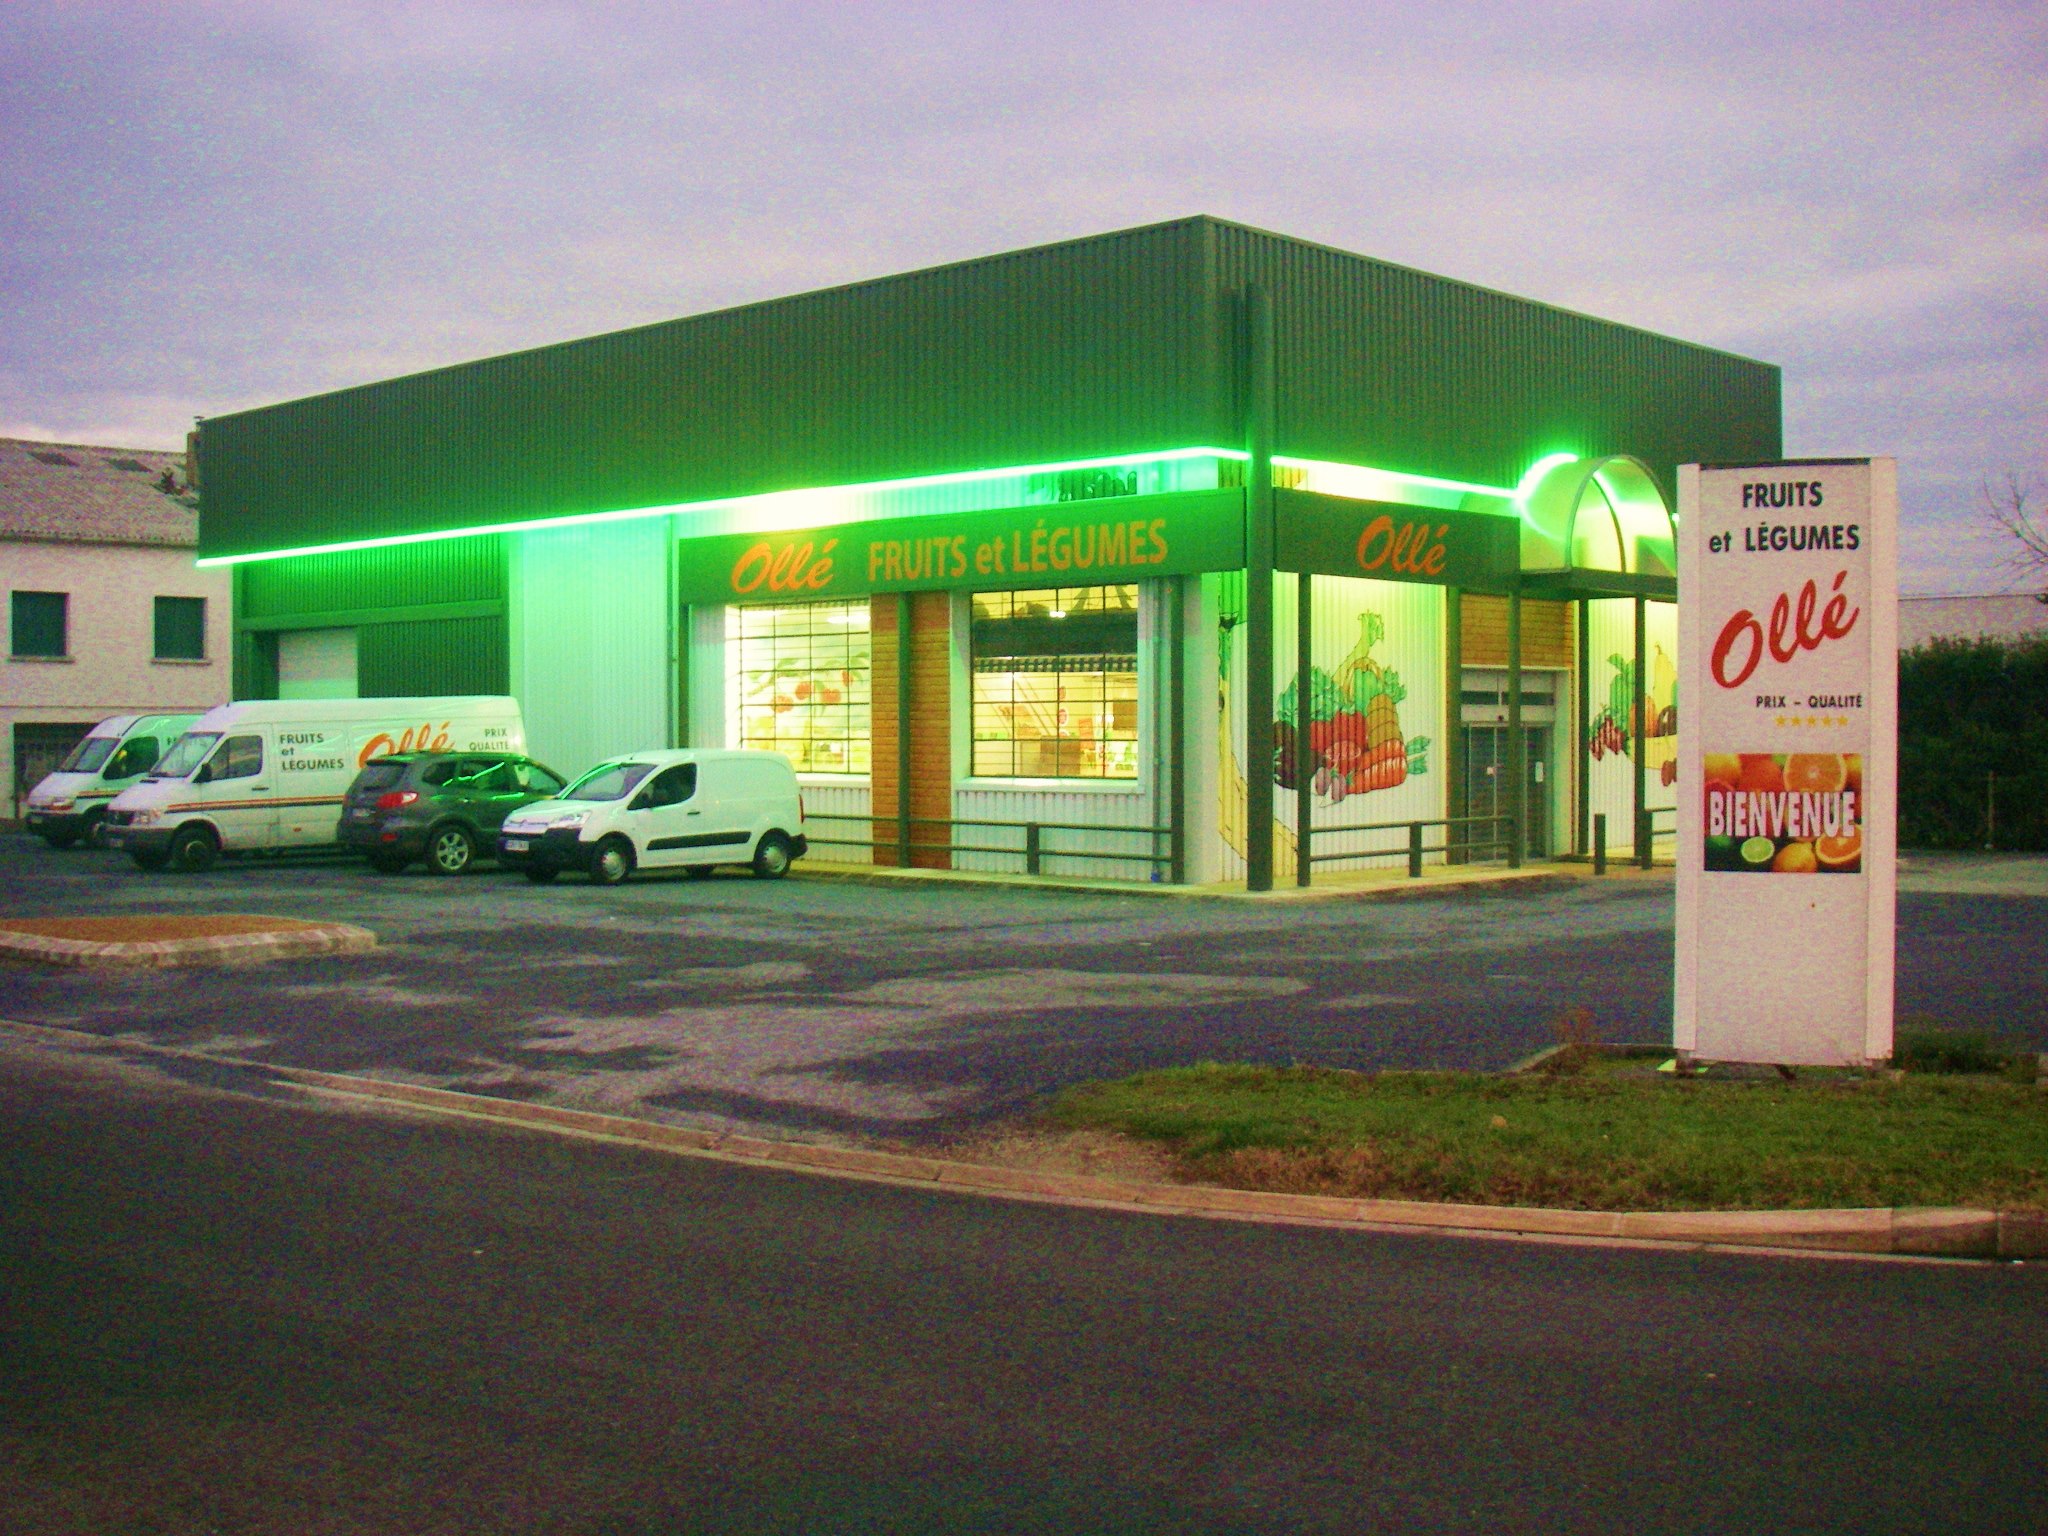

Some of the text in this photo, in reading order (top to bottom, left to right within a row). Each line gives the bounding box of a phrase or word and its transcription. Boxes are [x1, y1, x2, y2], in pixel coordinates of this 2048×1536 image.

[1743, 481, 1823, 507] FRUITS
[1356, 515, 1450, 576] Ollé
[1709, 521, 1860, 552] et LÉGUMES
[731, 518, 1168, 594] Ollé FRUITS et LÉGUMES
[1711, 570, 1860, 688] Ollé
[1756, 695, 1786, 708] PRIX
[279, 733, 324, 744] FRUITS
[485, 728, 507, 738] PRIX
[281, 747, 294, 756] et
[1709, 791, 1856, 838] BIENVENUE
